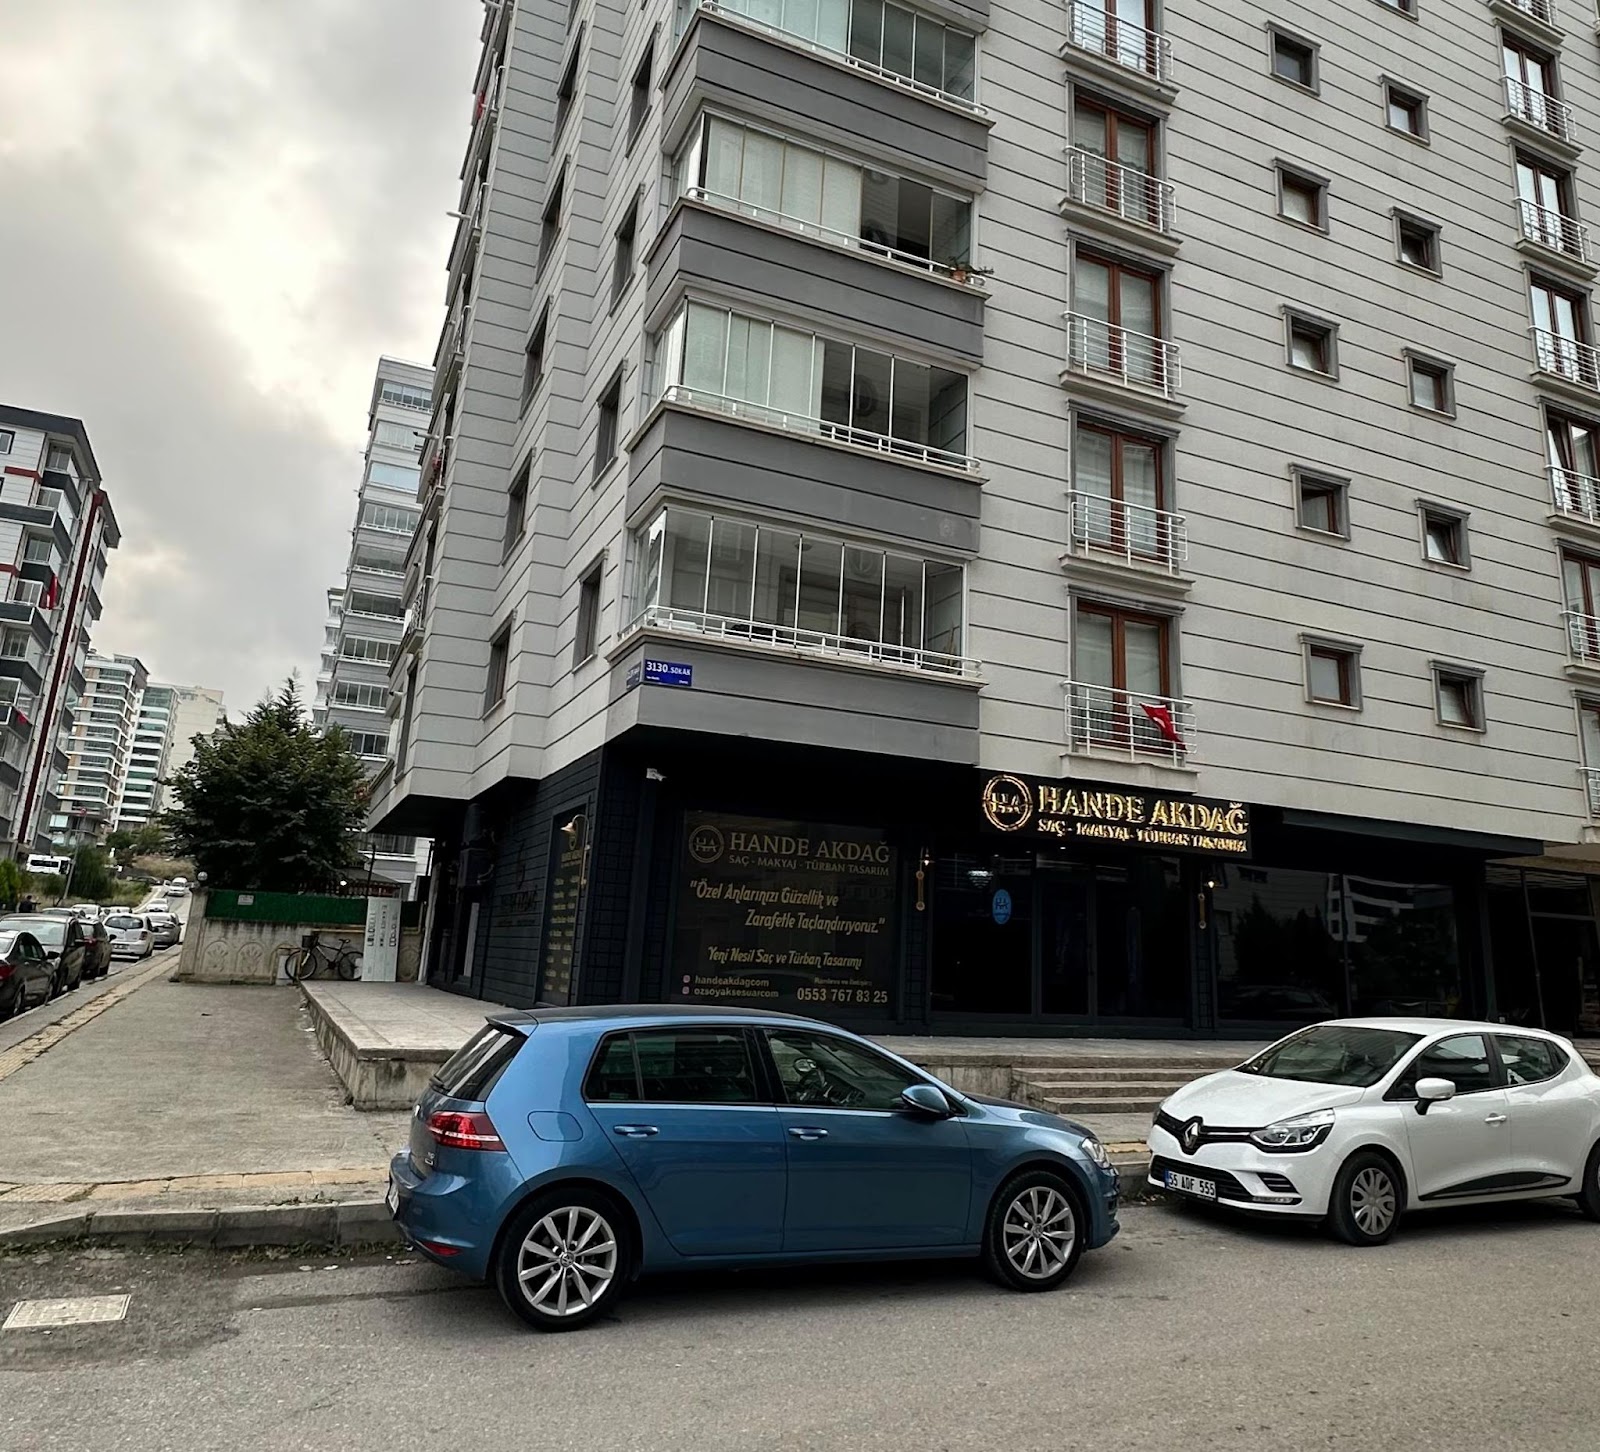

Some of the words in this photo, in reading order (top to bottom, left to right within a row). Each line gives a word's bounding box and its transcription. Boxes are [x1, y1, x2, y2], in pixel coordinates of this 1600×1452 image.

[671, 667, 691, 675] SOKAK
[1038, 785, 1146, 824] HANDE
[1149, 802, 1249, 835] AKDAĞ
[1037, 818, 1066, 837] SAÇ
[730, 832, 809, 857] HANDE
[815, 840, 890, 863] AKDAĞ
[729, 855, 750, 866] SAÇ
[758, 857, 797, 869] MAKYAJ
[806, 860, 845, 872] TÜRBAN
[849, 864, 889, 875] TASARIM
[725, 883, 779, 905] Anlarınızı
[781, 887, 824, 909] Güzellik
[826, 896, 839, 906] ve
[745, 909, 795, 930] Zarafetle
[708, 946, 729, 964] Yeni
[730, 948, 755, 962] Nesil
[756, 949, 773, 965] Saç
[776, 954, 787, 963] ve
[789, 950, 822, 968] Türban
[823, 952, 862, 970] Tasarımı
[797, 987, 826, 1001] 0553
[831, 989, 852, 1002] 767
[856, 990, 870, 1002] 83
[873, 991, 888, 1003] 25
[1169, 1173, 1177, 1186] 55
[1200, 1180, 1215, 1195] 555
